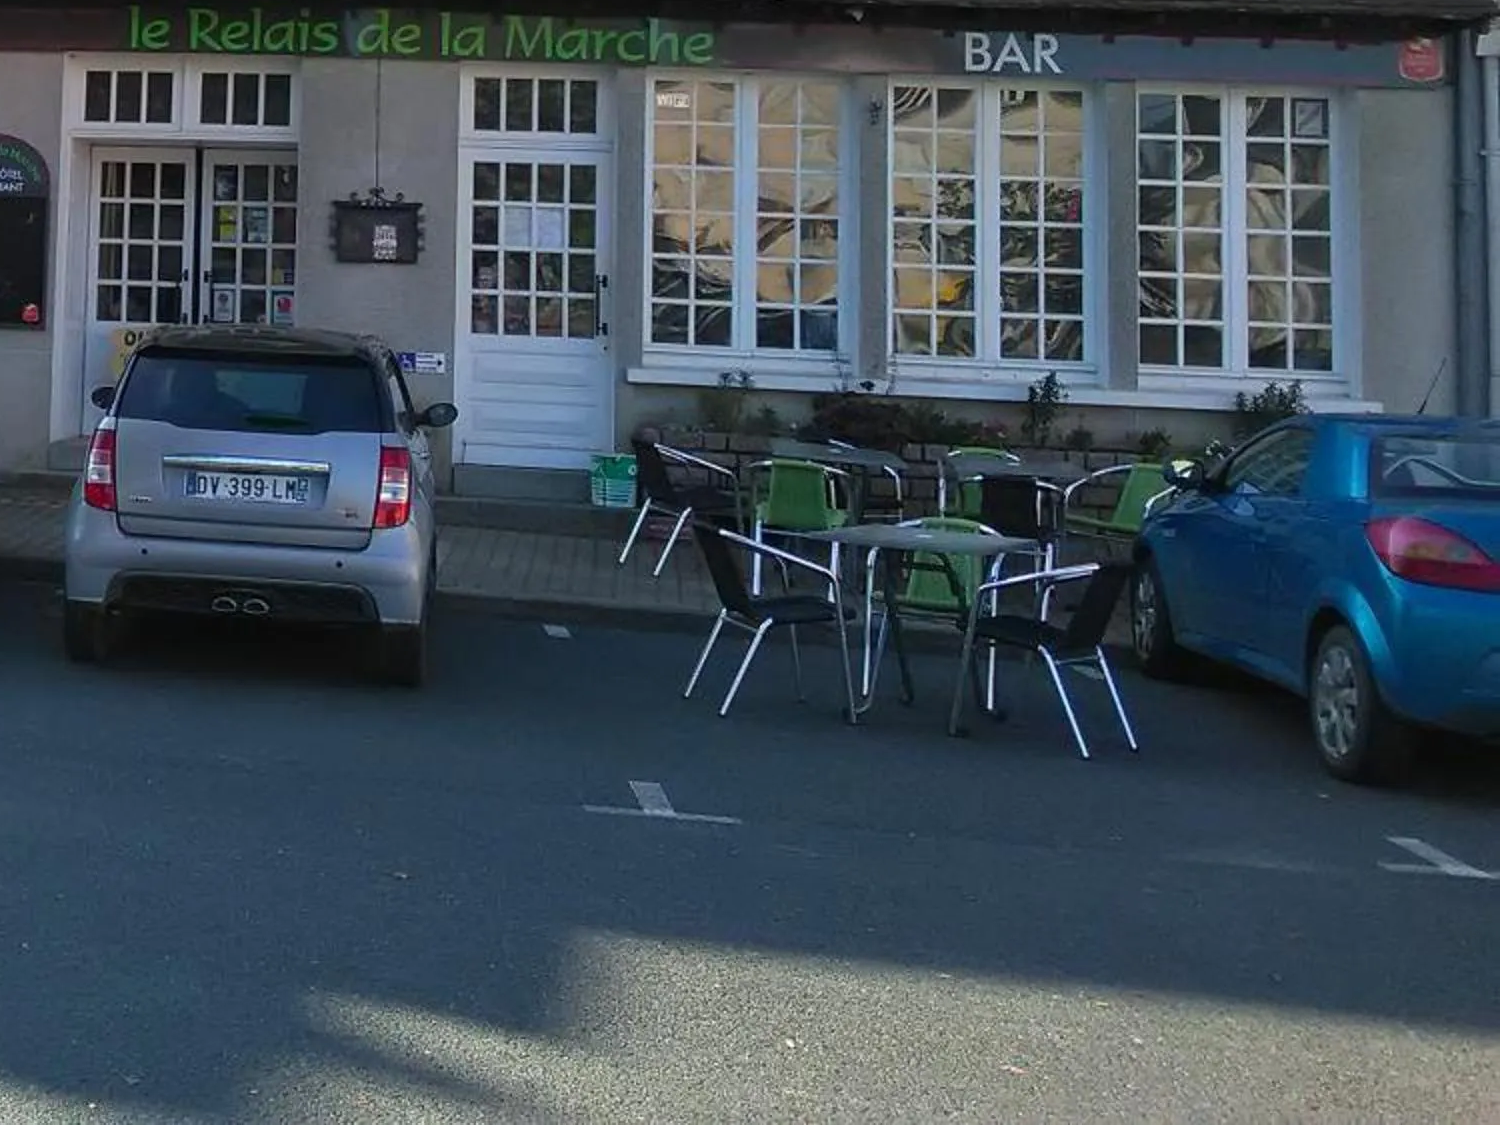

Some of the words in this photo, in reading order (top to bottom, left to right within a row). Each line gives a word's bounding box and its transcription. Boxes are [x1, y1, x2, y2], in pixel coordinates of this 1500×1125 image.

[129, 5, 170, 49] le
[187, 7, 338, 53] Relais
[357, 8, 421, 54] de
[439, 12, 485, 57] la
[504, 15, 714, 64] Marche
[964, 31, 1063, 74] BAR
